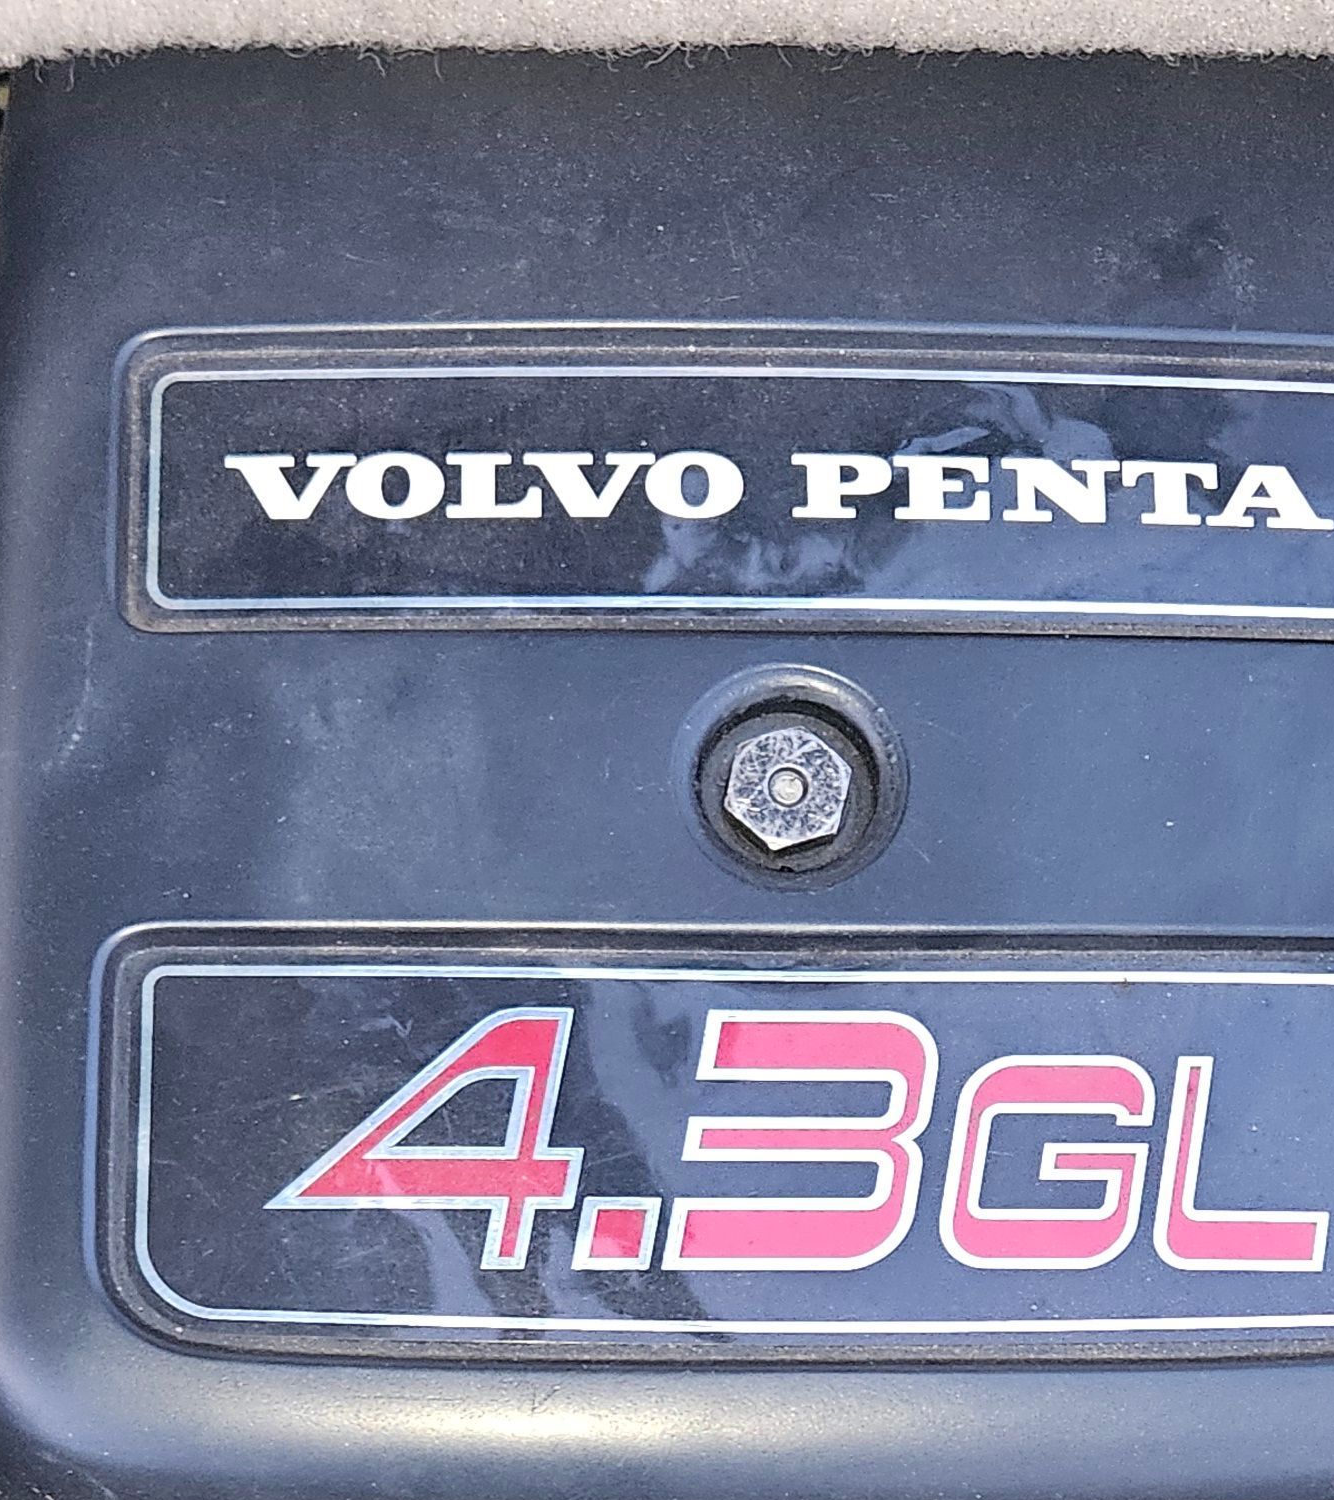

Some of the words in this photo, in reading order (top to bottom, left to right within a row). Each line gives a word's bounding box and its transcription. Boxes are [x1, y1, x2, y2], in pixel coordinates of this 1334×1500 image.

[223, 452, 745, 520] VOLVO
[791, 452, 1334, 532] PENTA
[264, 1006, 1329, 1273] 4.3GL
